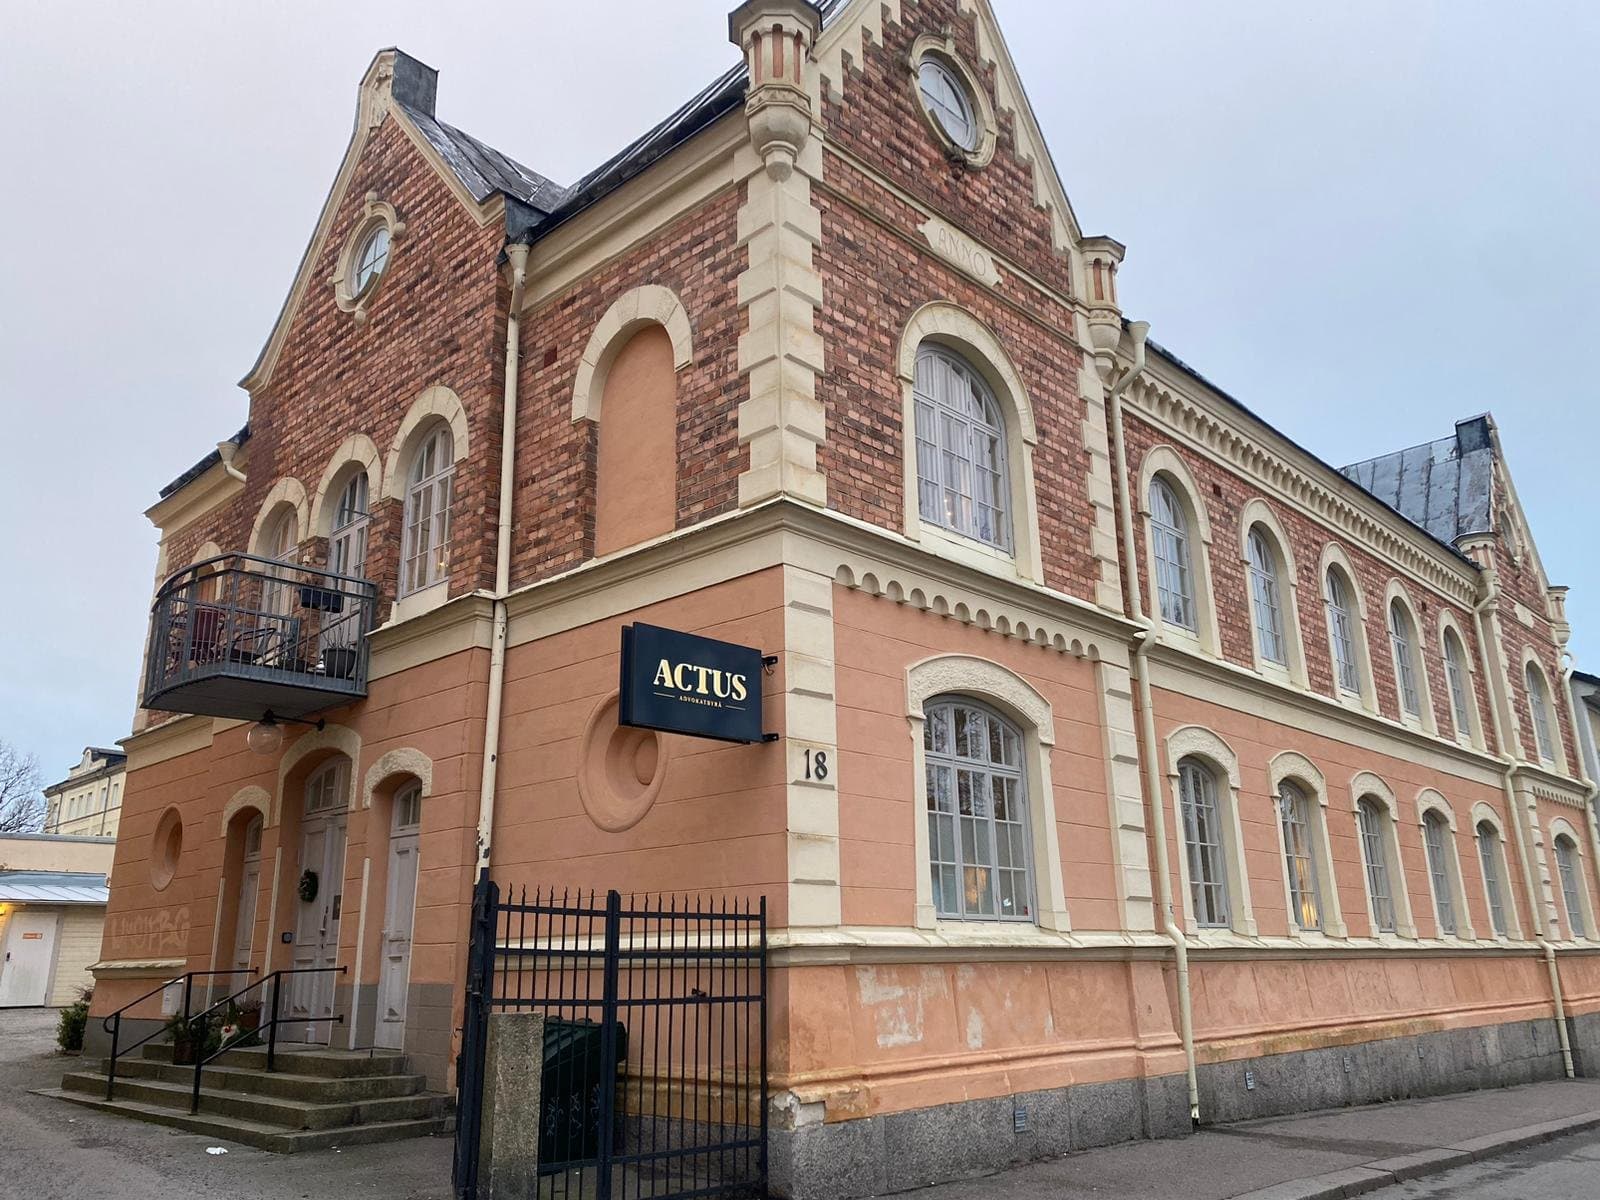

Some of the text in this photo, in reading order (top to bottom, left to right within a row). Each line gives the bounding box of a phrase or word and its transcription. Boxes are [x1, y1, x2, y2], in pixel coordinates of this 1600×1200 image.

[938, 227, 986, 276] ANNO
[653, 658, 747, 701] ACTUS
[804, 749, 828, 780] 18
